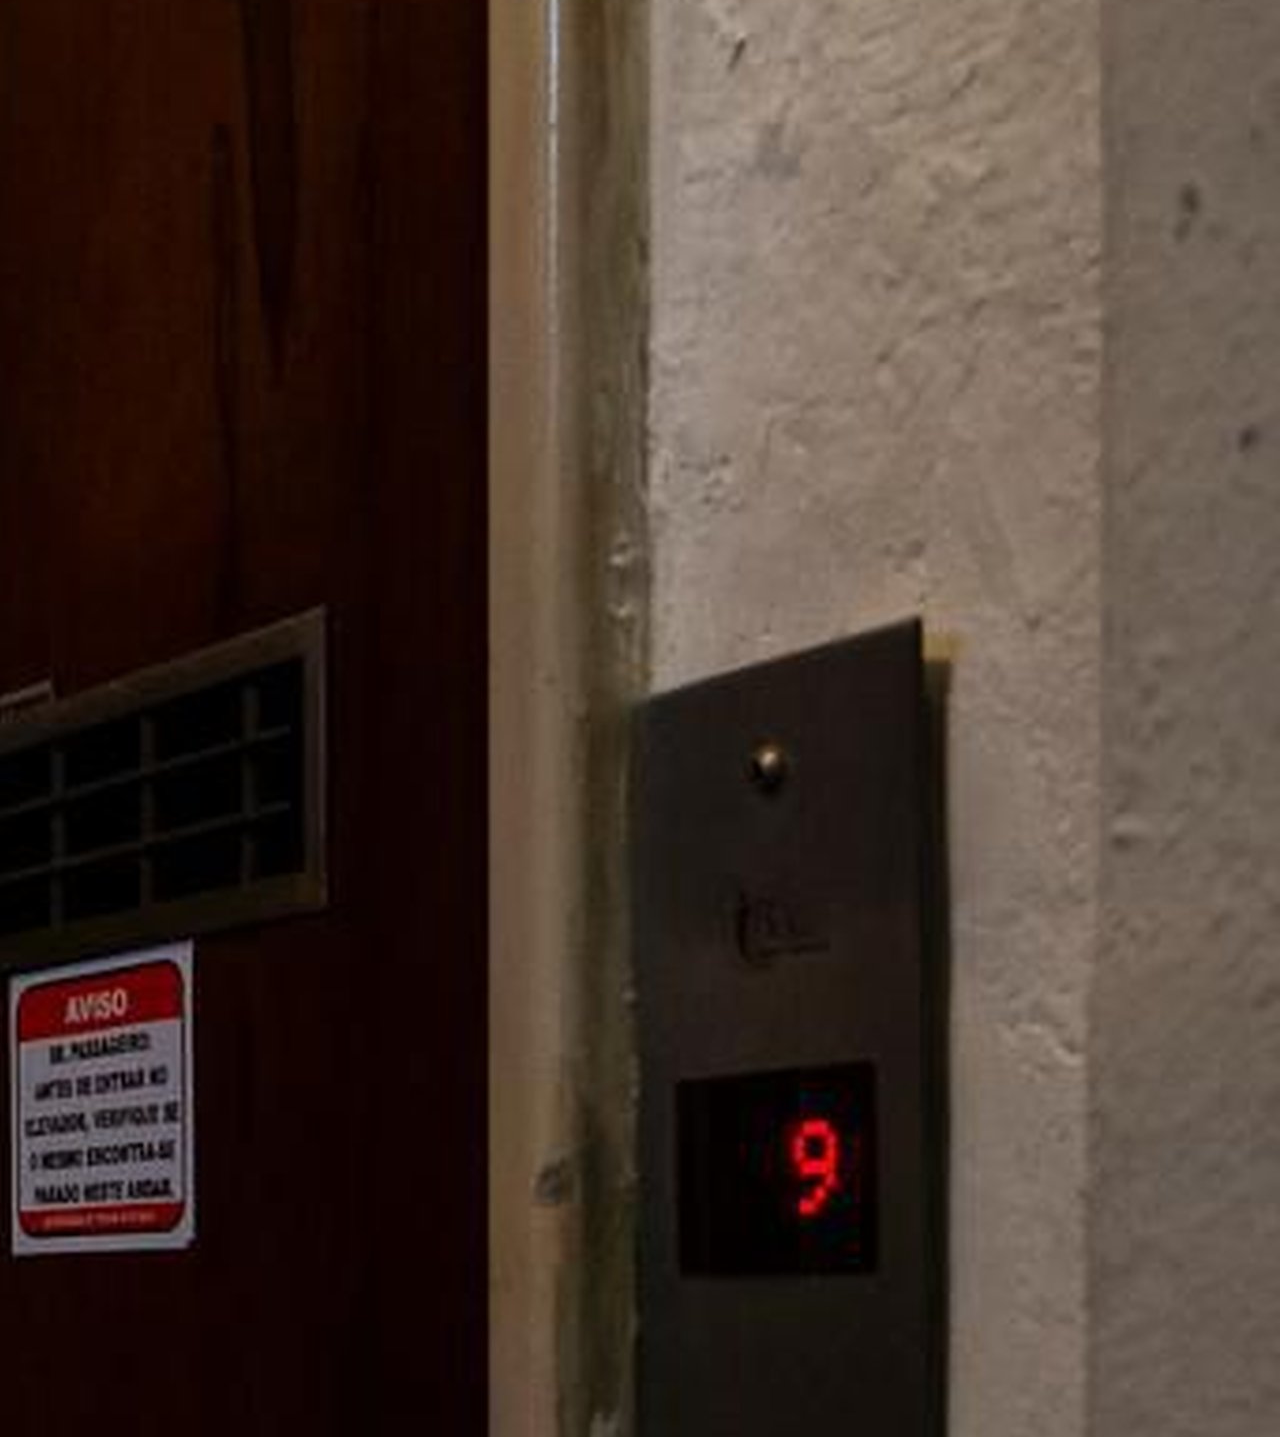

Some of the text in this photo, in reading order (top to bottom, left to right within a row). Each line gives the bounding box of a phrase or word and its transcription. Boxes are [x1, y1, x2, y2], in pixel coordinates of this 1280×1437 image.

[64, 988, 127, 1023] AVISO
[34, 1065, 168, 1101] ANTES DE ENTRAR NO
[790, 1118, 838, 1218] 9
